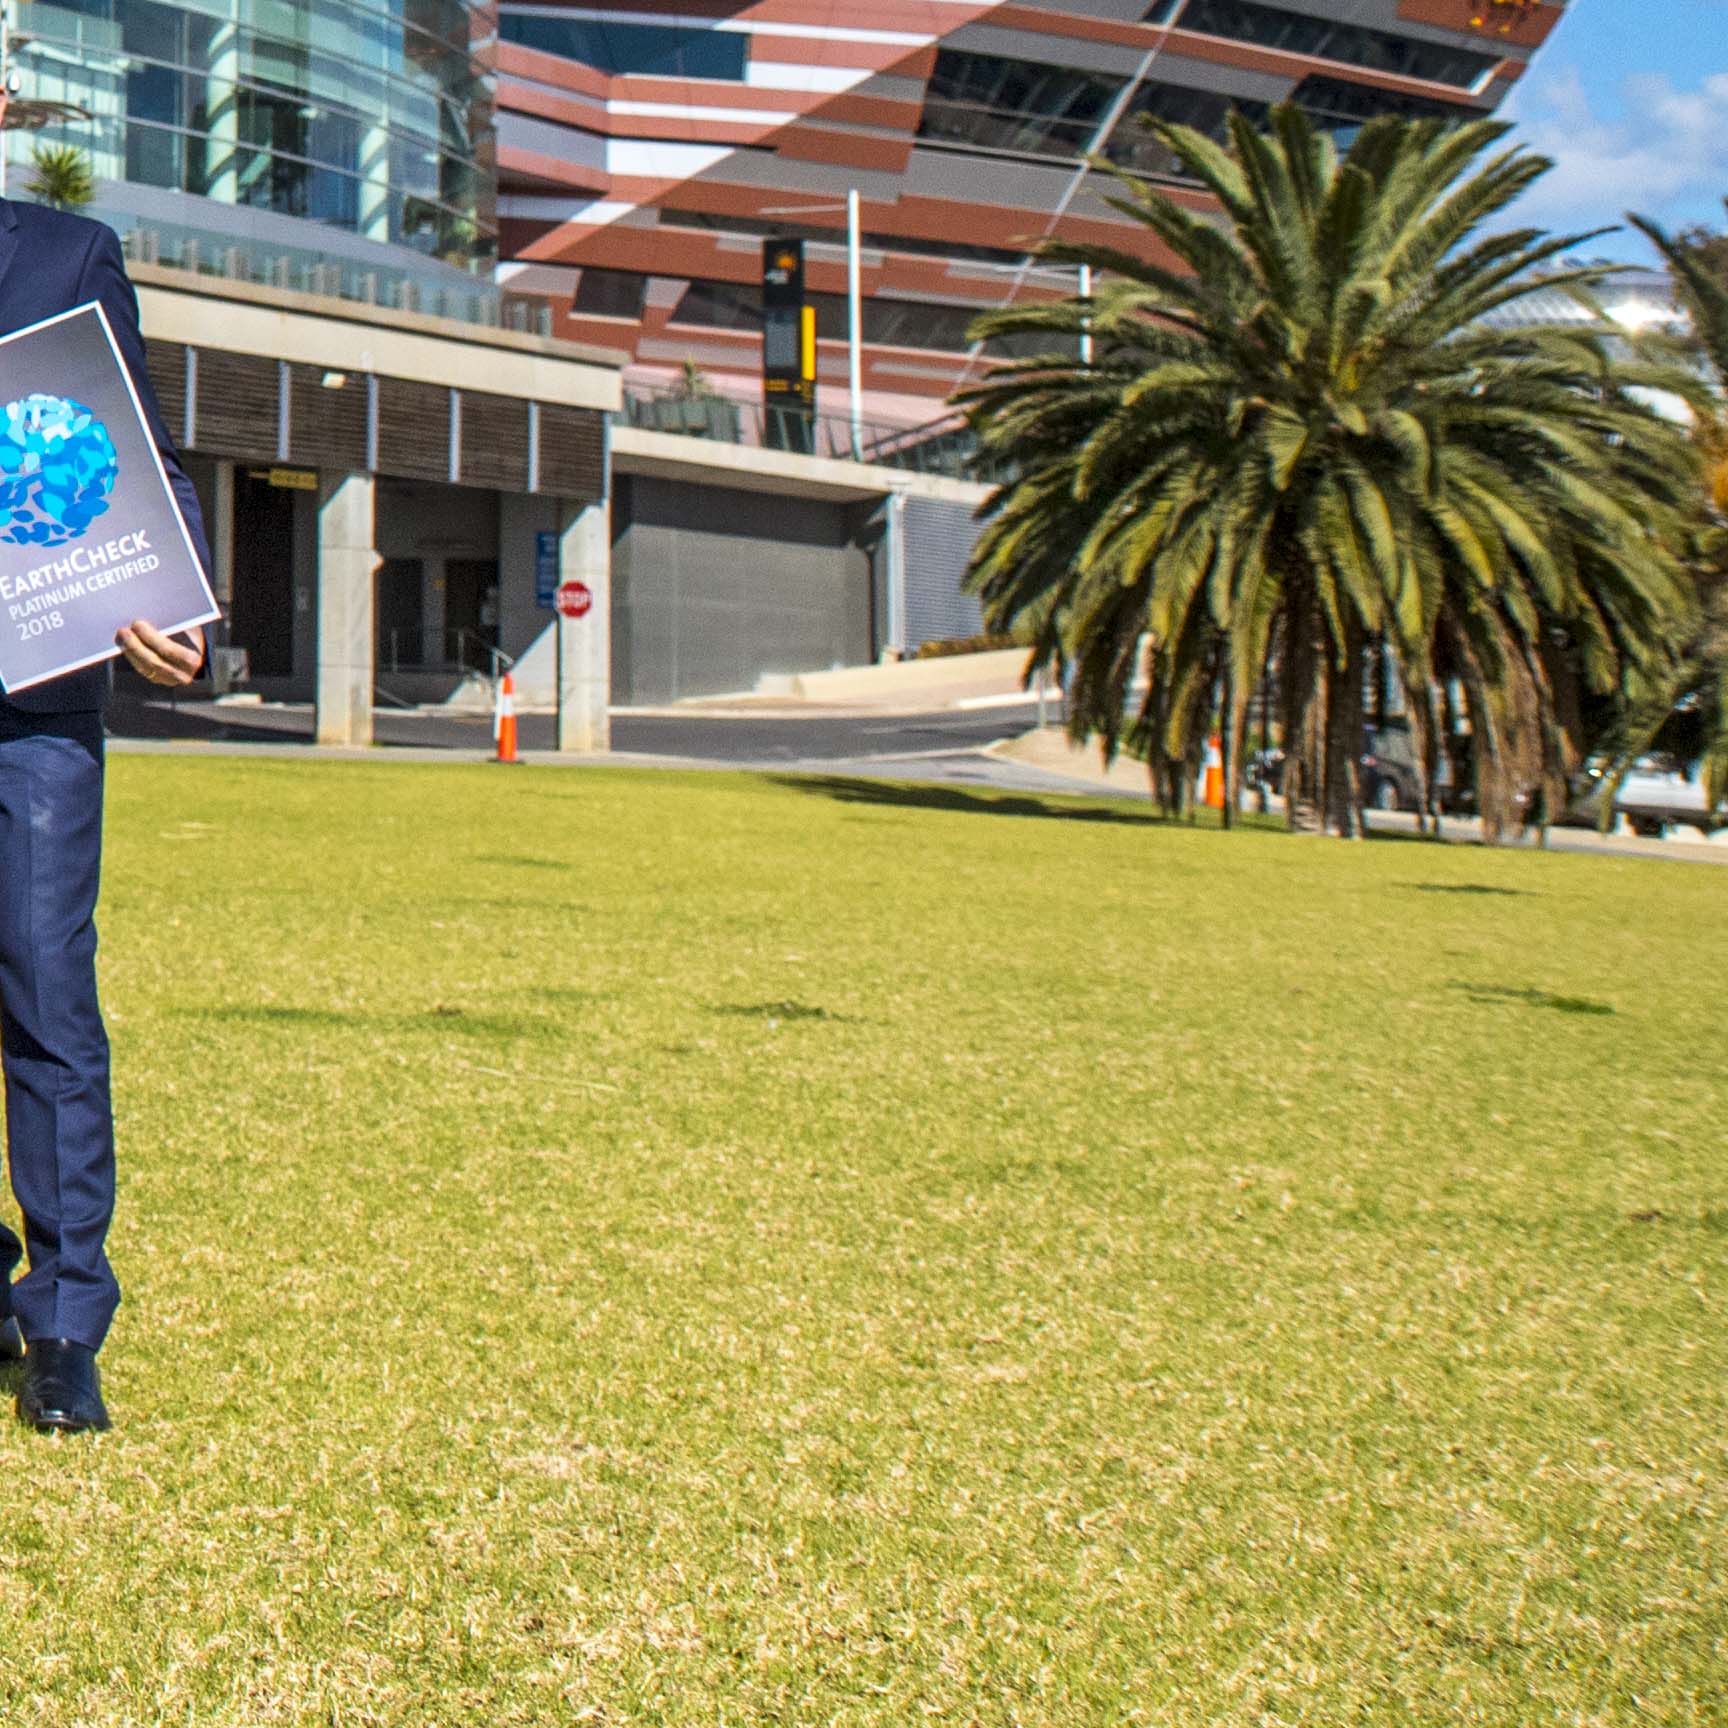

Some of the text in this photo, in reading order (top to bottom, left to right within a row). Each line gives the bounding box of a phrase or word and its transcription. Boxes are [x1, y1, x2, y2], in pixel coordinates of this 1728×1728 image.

[8, 554, 160, 620] PLATINUM CERTIFIED
[555, 590, 592, 609] STOP
[16, 610, 64, 640] 2018
